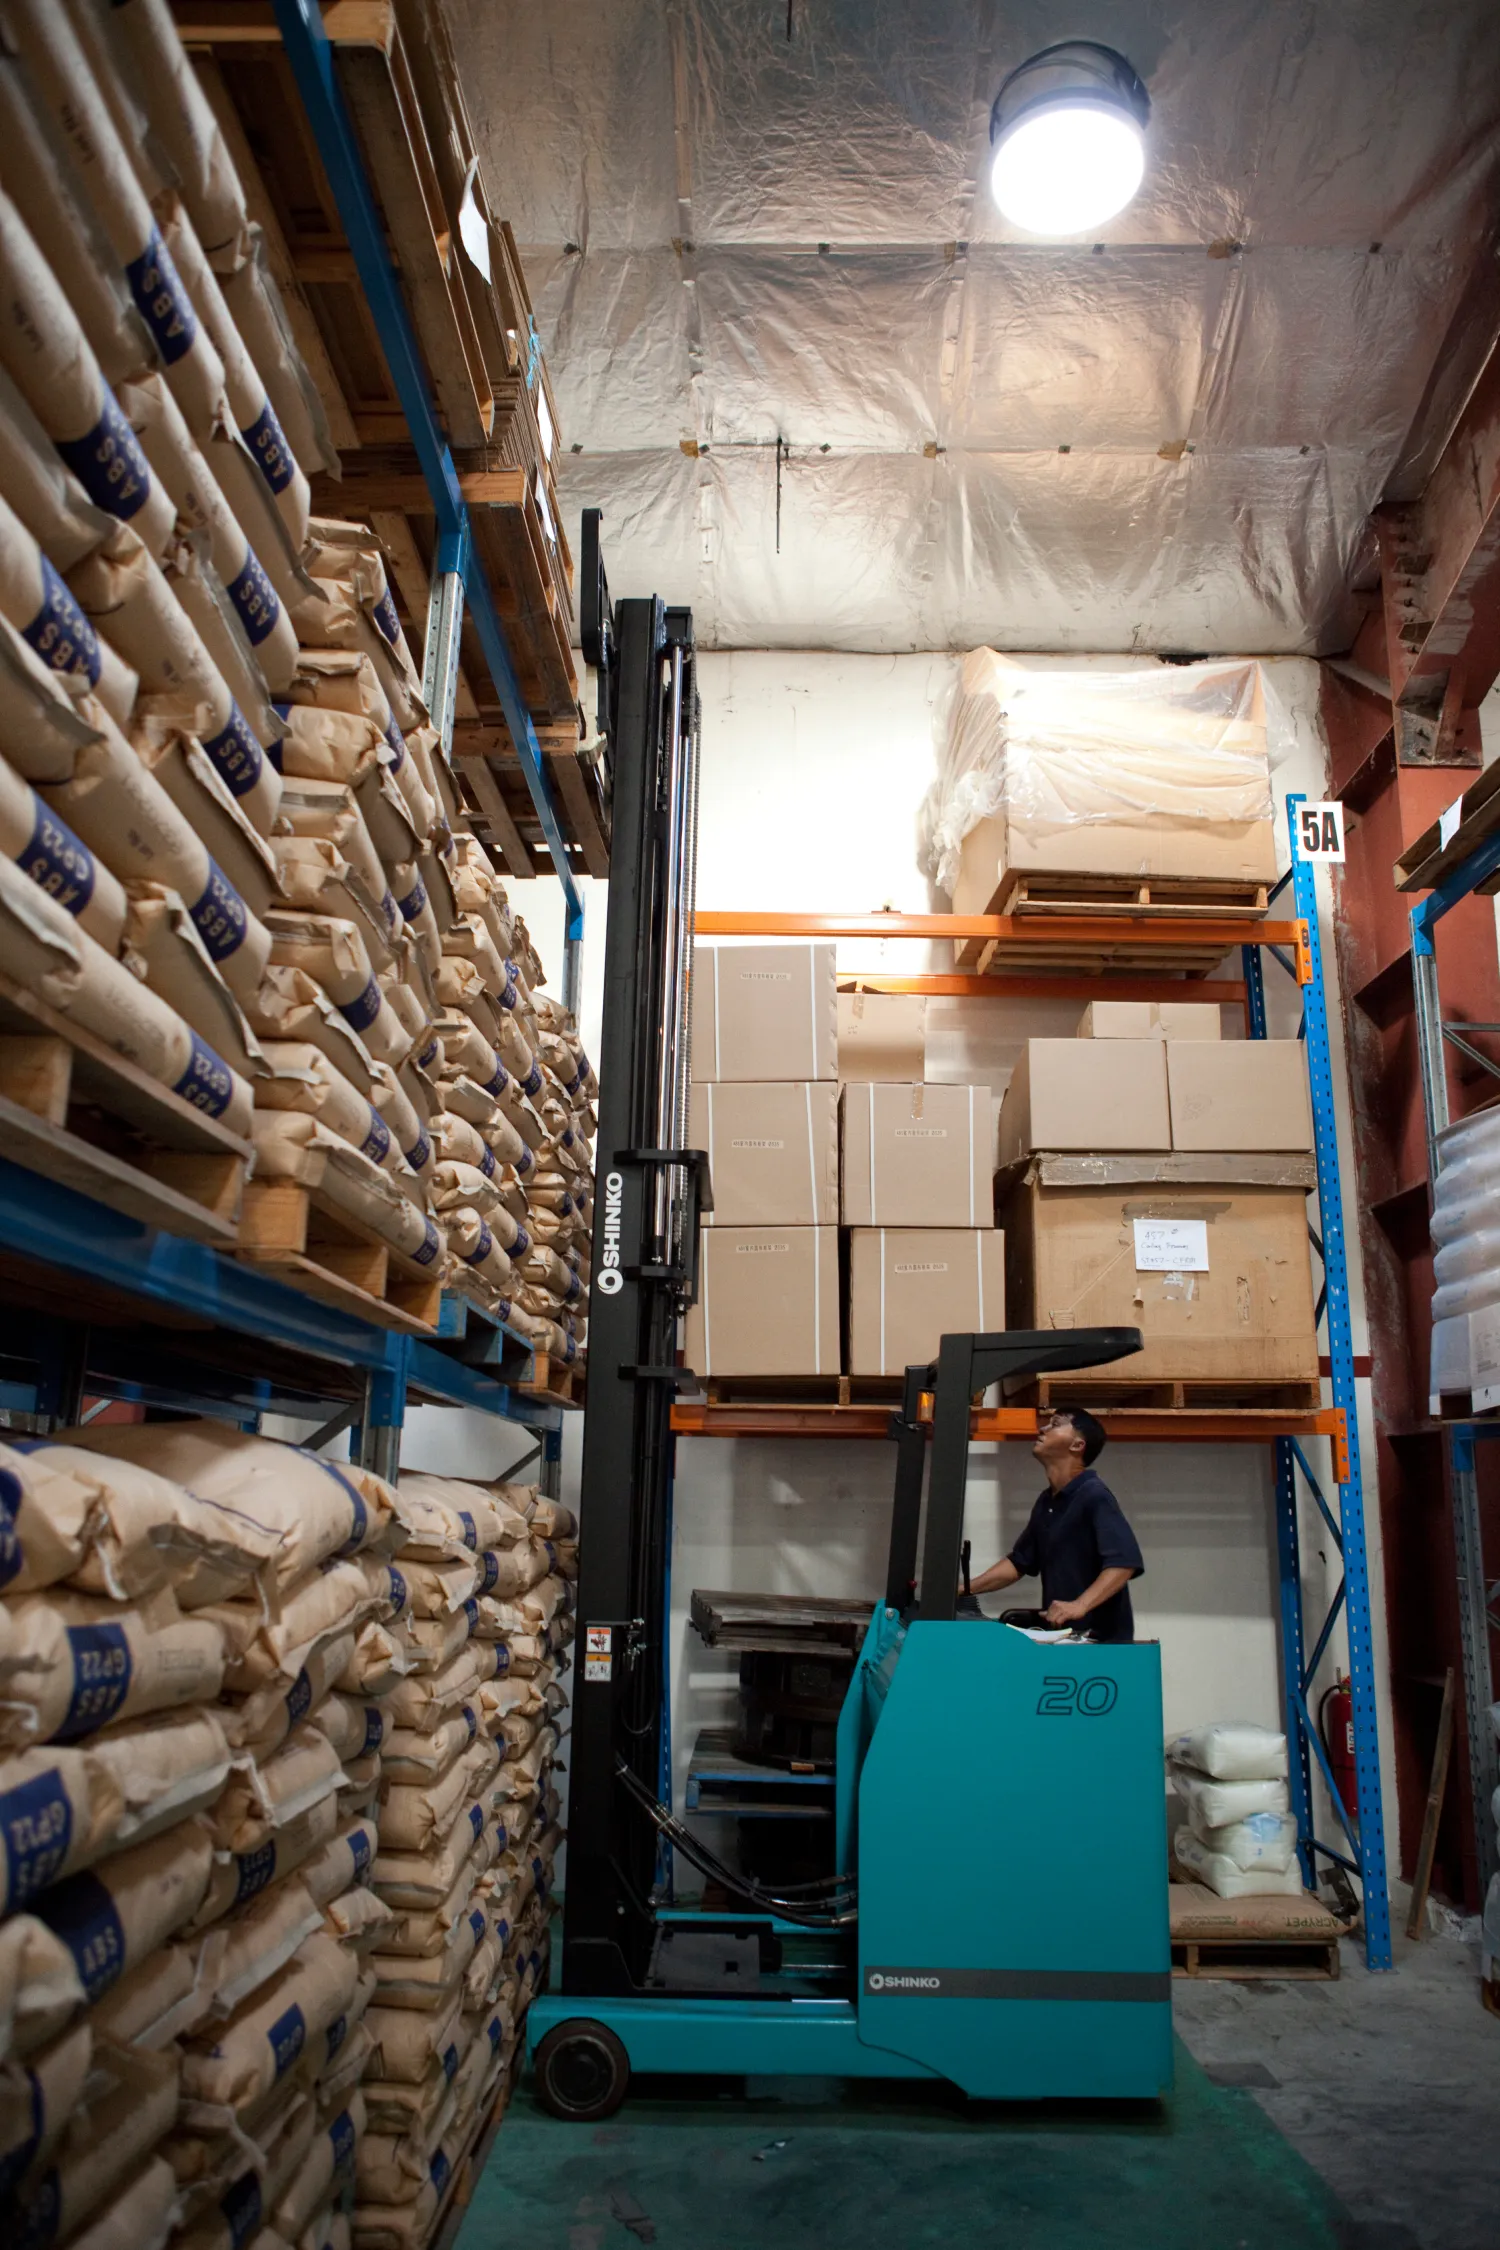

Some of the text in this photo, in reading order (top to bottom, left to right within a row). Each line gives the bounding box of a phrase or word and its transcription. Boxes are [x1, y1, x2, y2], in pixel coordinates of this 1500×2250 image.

[142, 267, 185, 338] ABS
[96, 435, 140, 500] ABS
[256, 427, 288, 479] ABS
[51, 582, 97, 656] GP22
[240, 579, 271, 627] ABS
[217, 737, 255, 781] ABS
[42, 818, 90, 881] GP22
[1301, 810, 1340, 852] 5A
[197, 904, 237, 948] ABS
[194, 1051, 231, 1097] GP22
[602, 1172, 623, 1269] SHINKO
[80, 1648, 126, 1681] GP22
[76, 1680, 121, 1718] ABS
[1036, 1676, 1118, 1716] 20
[10, 1800, 66, 1856] GP22
[83, 1925, 118, 1974] ABS
[884, 1975, 941, 1989] SHINKO
